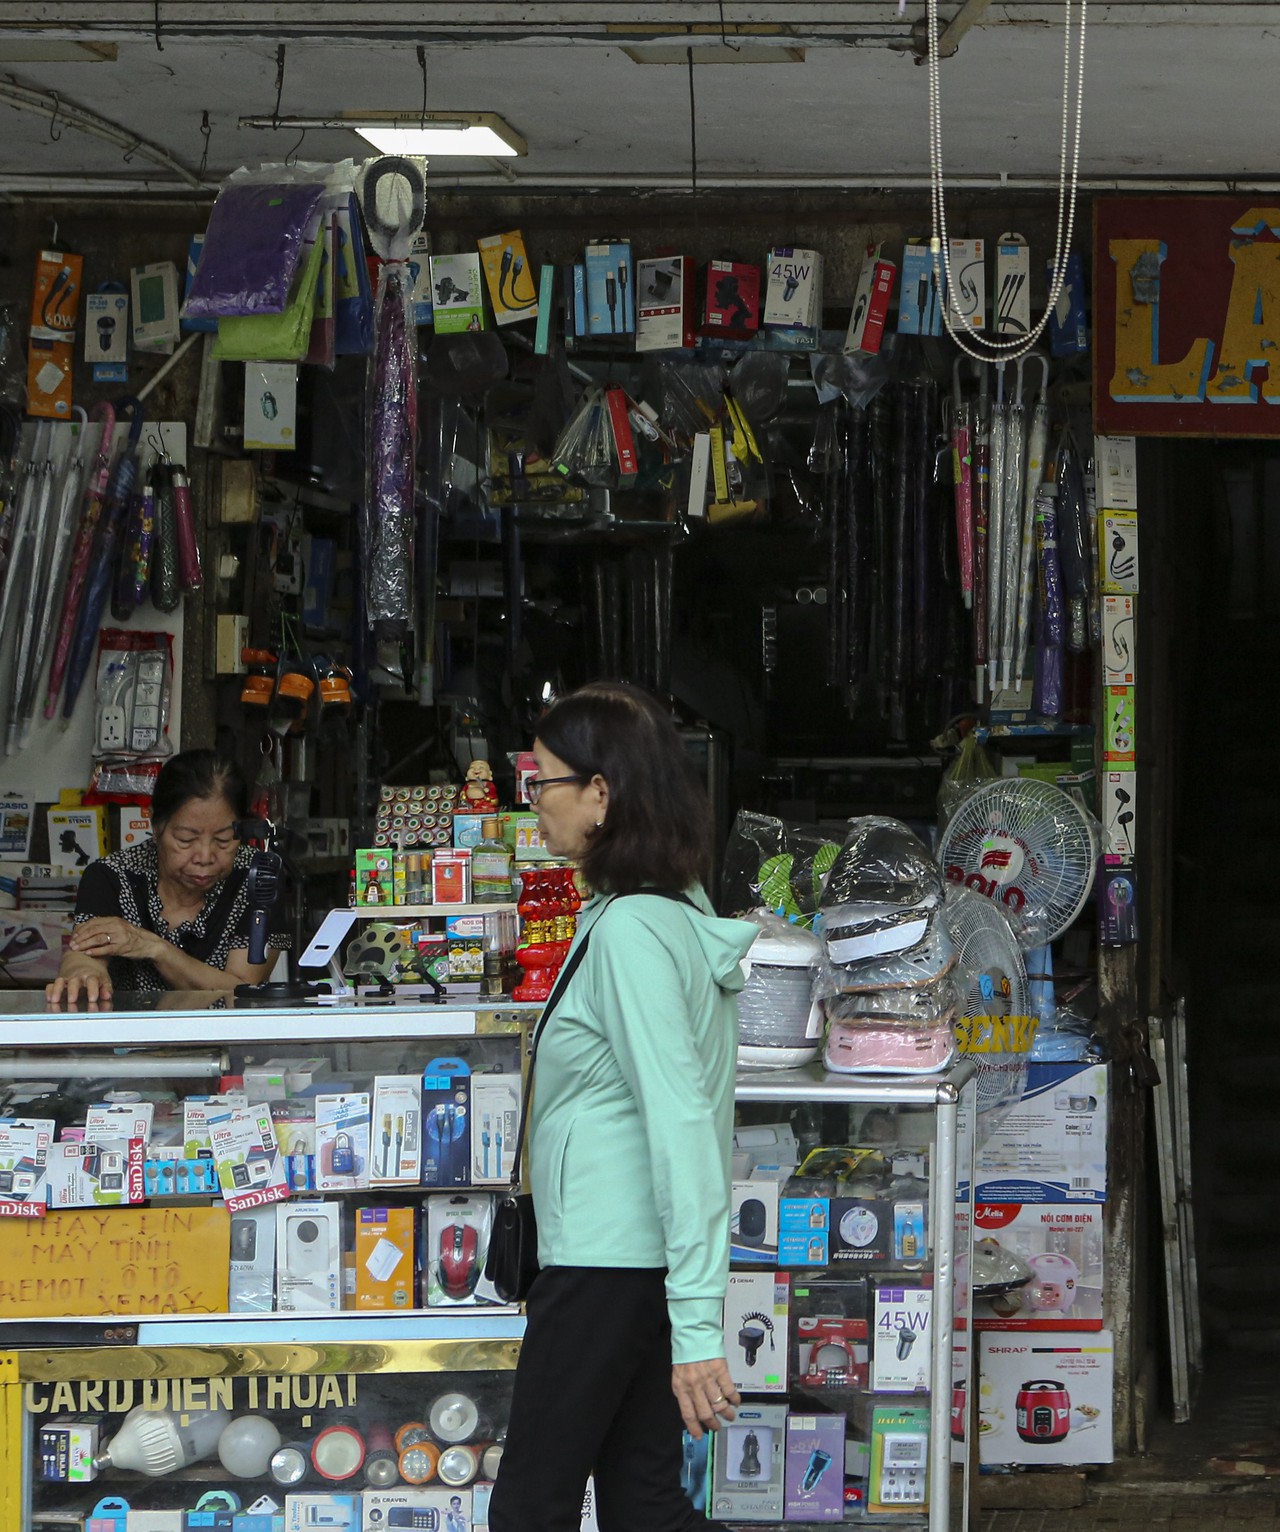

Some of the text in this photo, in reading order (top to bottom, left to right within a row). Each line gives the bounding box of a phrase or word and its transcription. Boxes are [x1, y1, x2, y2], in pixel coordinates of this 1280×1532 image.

[772, 264, 810, 280] 45W
[45, 312, 75, 328] 60W
[0, 802, 28, 810] CASIO
[187, 1111, 205, 1119] Ultra
[213, 1131, 232, 1141] Ultra
[130, 1142, 143, 1200] SanDisk
[229, 1187, 285, 1212] SanDisk
[975, 1207, 1004, 1219] Melia
[1055, 1214, 1073, 1223] CƠM
[1075, 1214, 1093, 1224] ĐIỆN
[25, 1215, 110, 1236] THAY
[32, 1233, 172, 1264] MÁY TÍNH
[121, 1261, 181, 1290] Ô TÔ
[0, 1278, 89, 1303] REMOT
[878, 1311, 930, 1331] 45W
[26, 1380, 134, 1414] CARD
